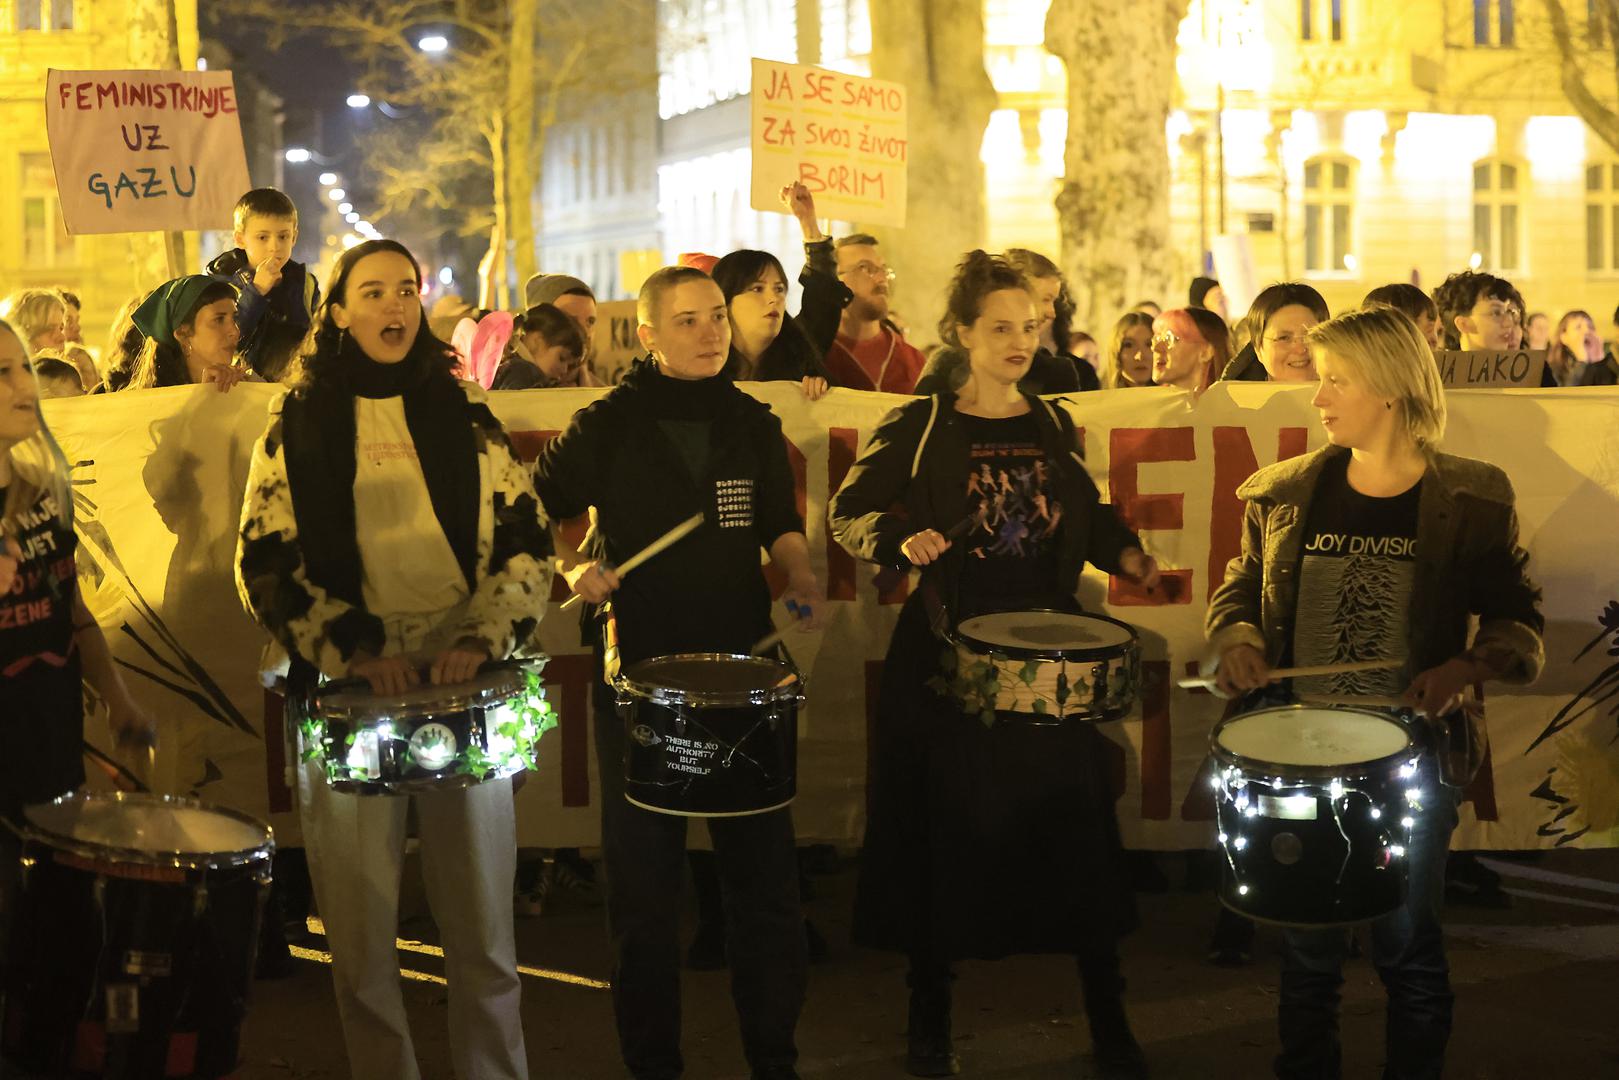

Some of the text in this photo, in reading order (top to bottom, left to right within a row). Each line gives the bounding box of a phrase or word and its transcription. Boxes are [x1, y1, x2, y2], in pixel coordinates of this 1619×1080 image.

[59, 80, 238, 118] FEMINISTKINJE
[764, 70, 902, 113] JA SE SAMO
[121, 123, 169, 151] UZ
[762, 117, 908, 162] ZA SVOJ ŽIVOT
[88, 165, 196, 208] GAZU
[799, 163, 885, 199] BORIM
[1467, 352, 1530, 383] LAKO
[1305, 534, 1347, 552] JOY
[666, 735, 718, 751] THERE IS NO
[666, 745, 714, 759] AUTHORITY
[667, 762, 711, 775] YOURSELF
[680, 756, 697, 765] BUT
